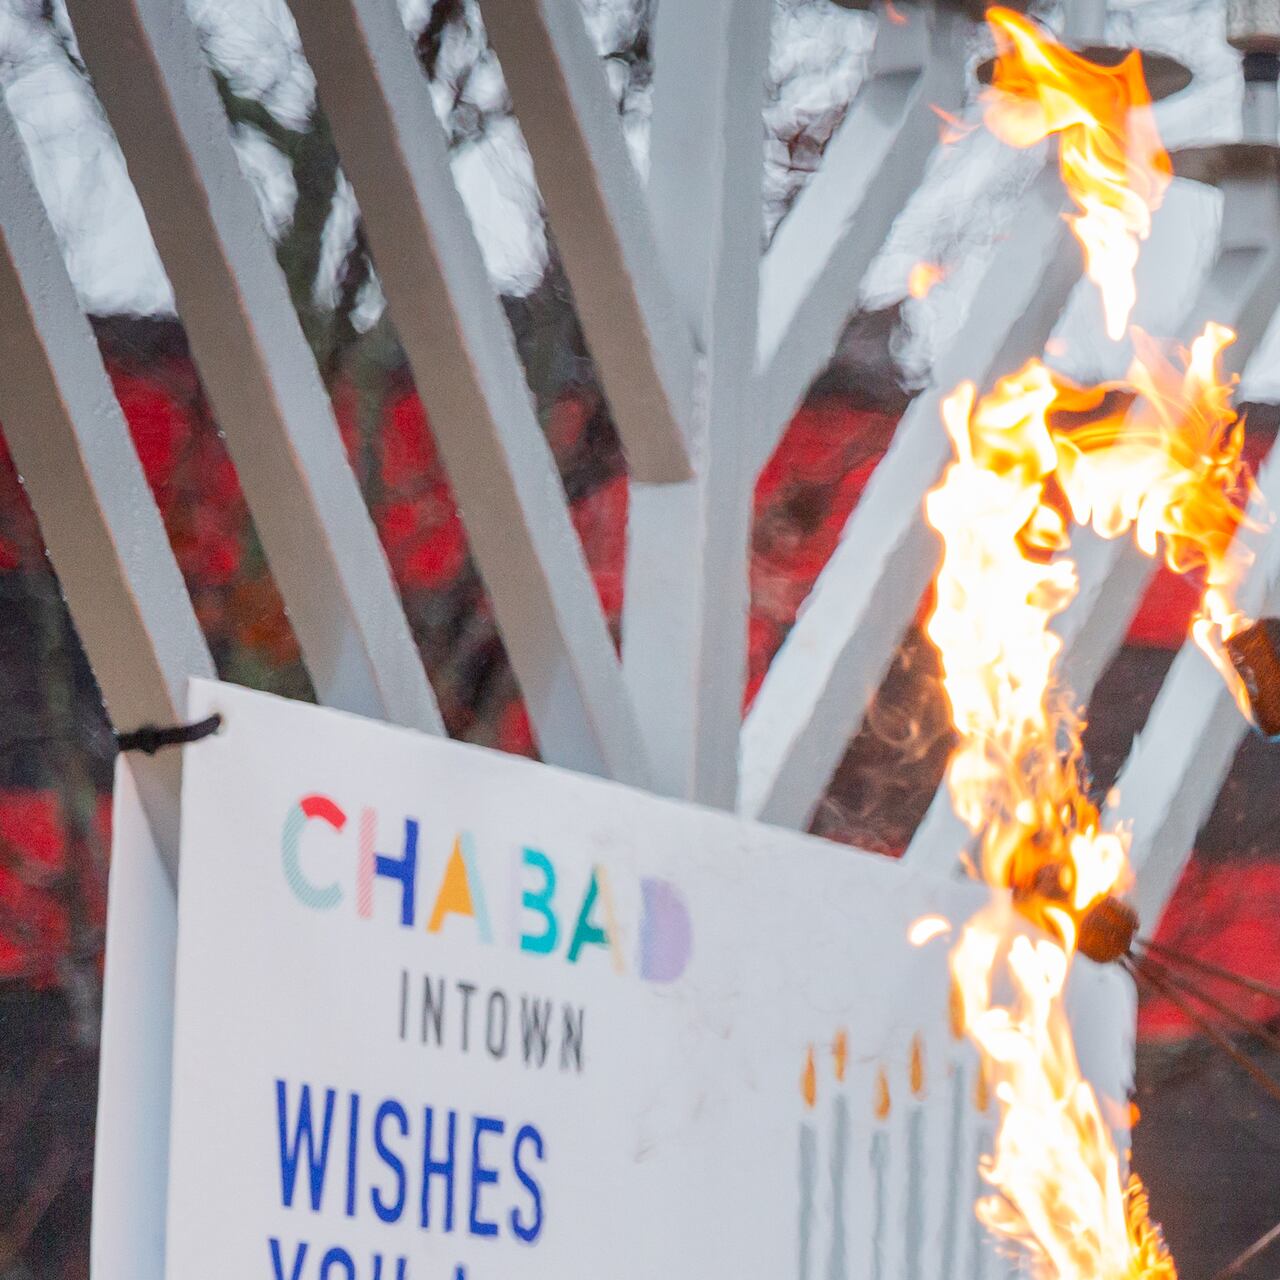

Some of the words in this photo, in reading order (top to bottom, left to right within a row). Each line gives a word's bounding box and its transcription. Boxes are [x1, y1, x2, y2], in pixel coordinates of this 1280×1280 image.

[280, 792, 694, 986] CHABAD
[398, 968, 586, 1073] INTOWN
[268, 1078, 546, 1250] WISHES
